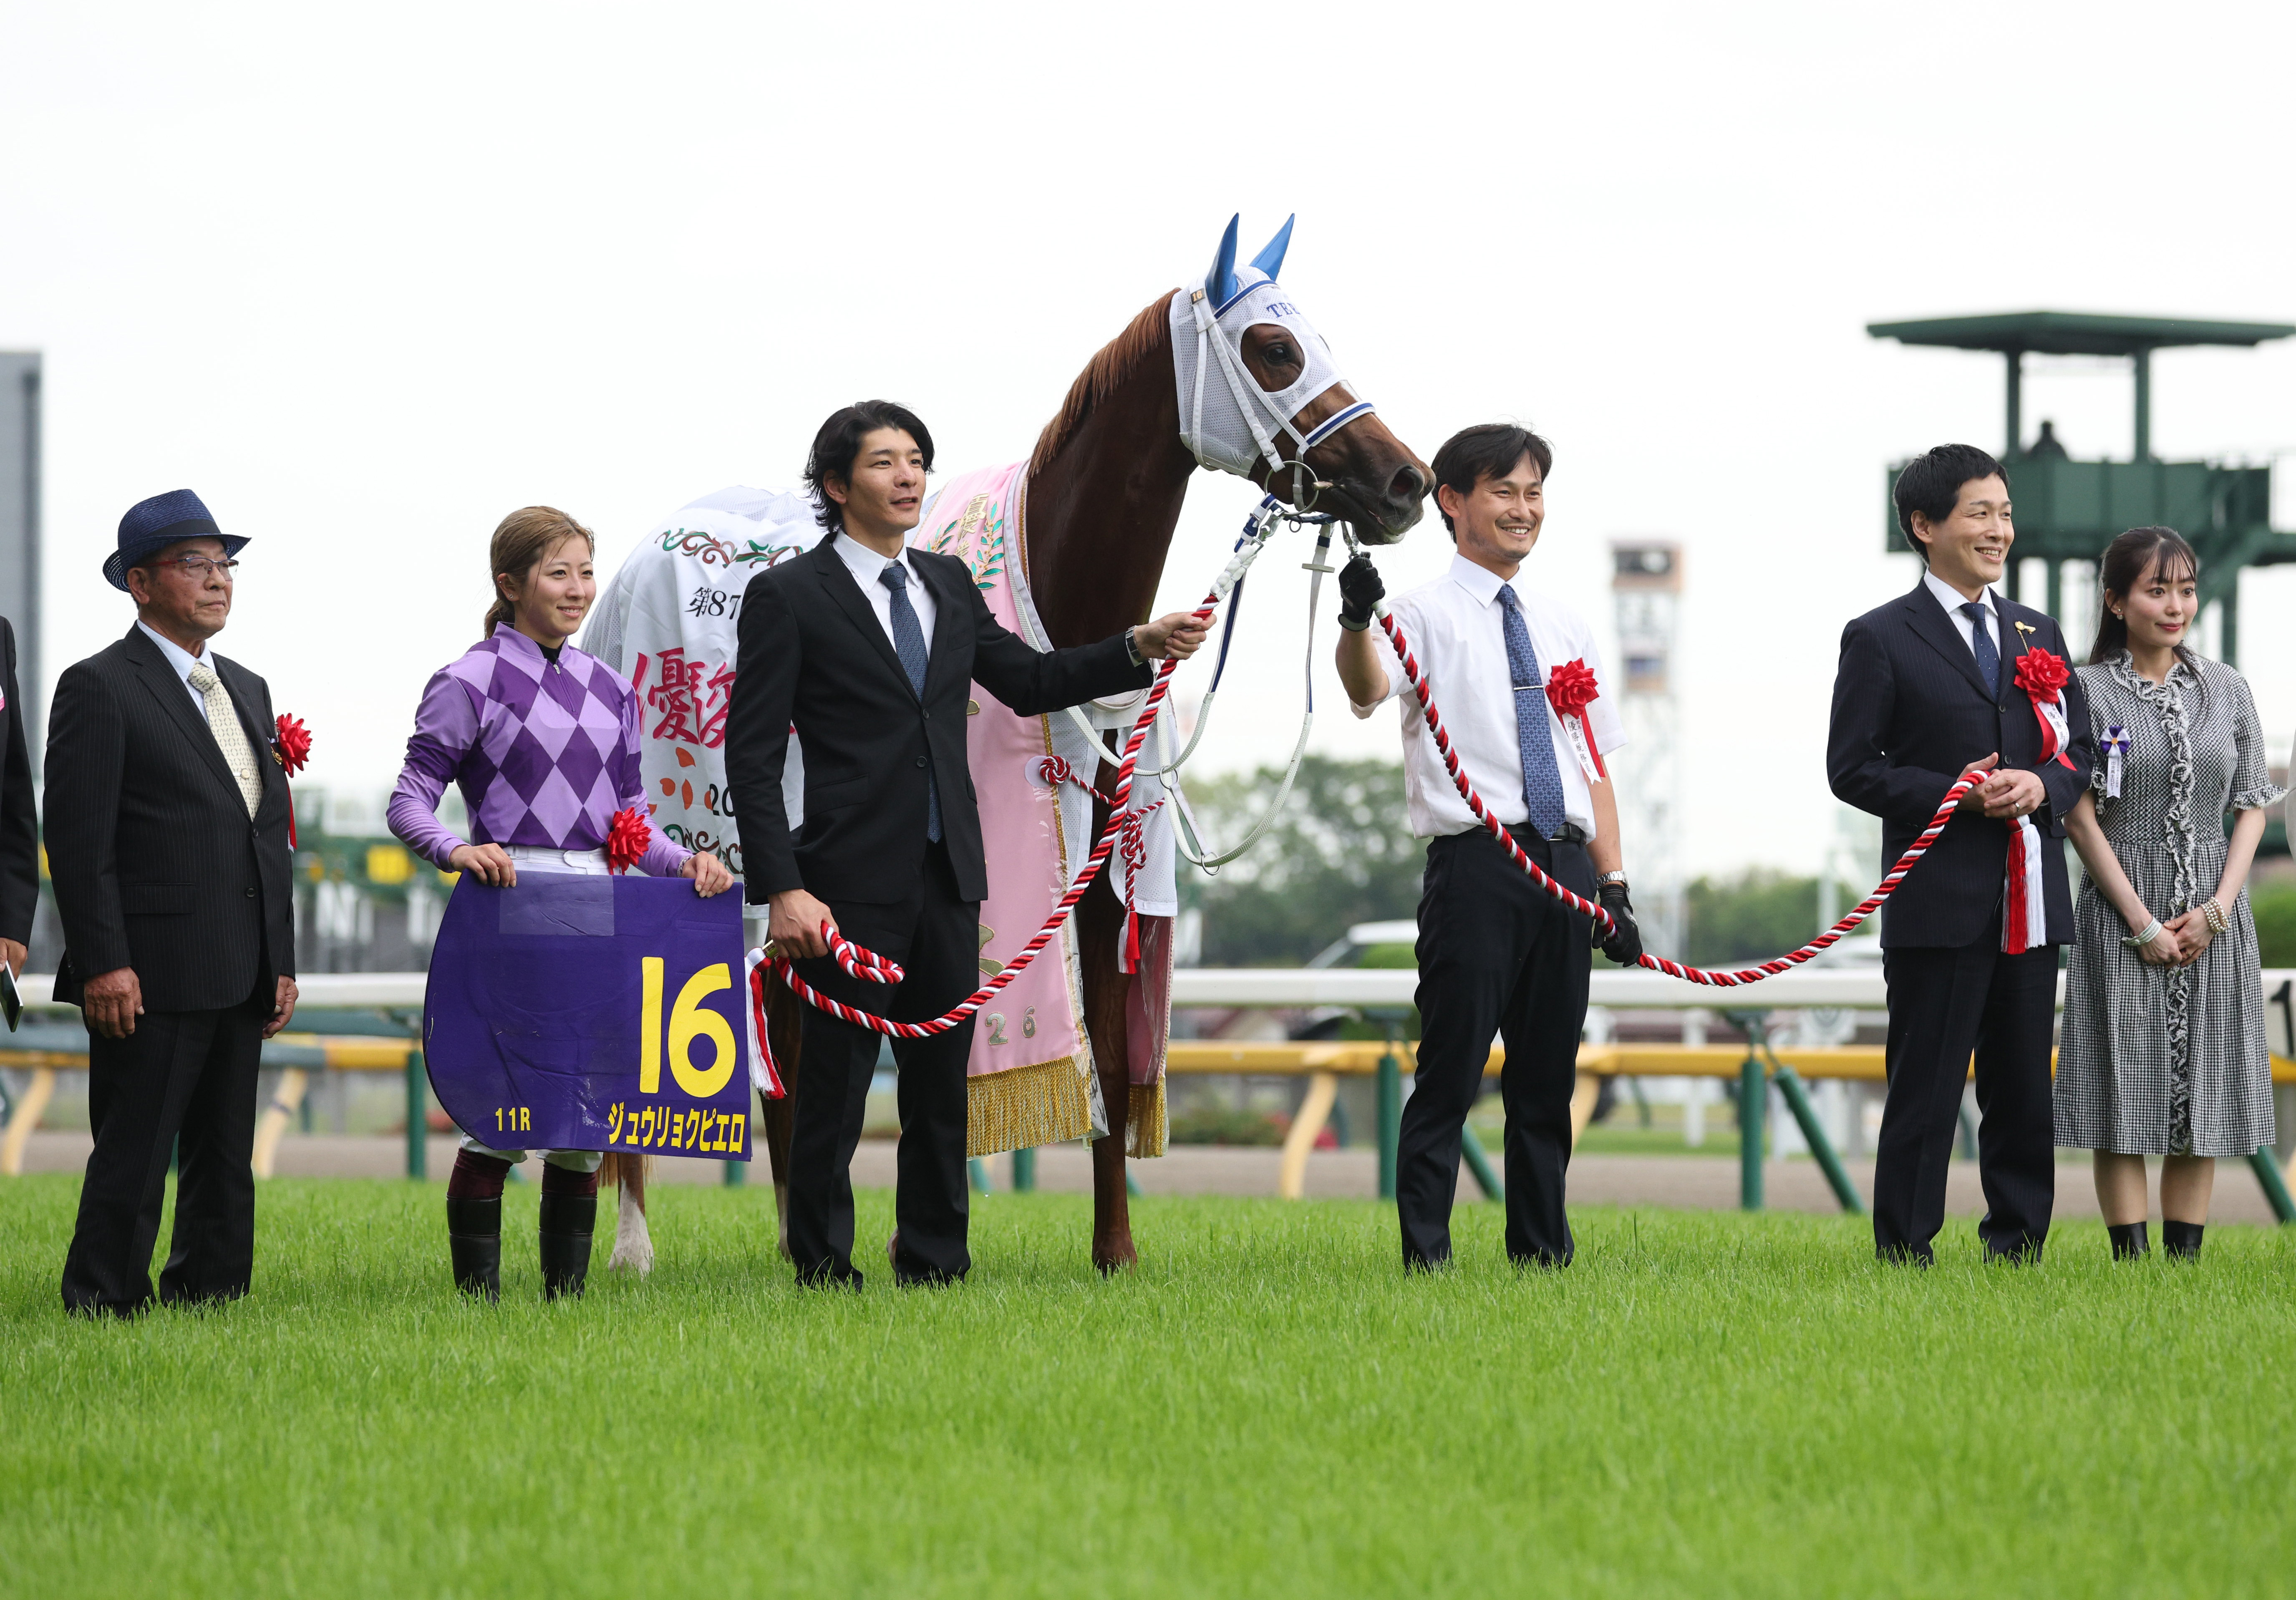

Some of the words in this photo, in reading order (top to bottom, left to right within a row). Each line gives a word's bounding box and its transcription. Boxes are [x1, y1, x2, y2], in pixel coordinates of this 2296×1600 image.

[1192, 290, 1202, 302] 16
[639, 957, 736, 1098] 16
[495, 1107, 531, 1131] 11R
[608, 1101, 745, 1153] ジュウリョクピエロ
